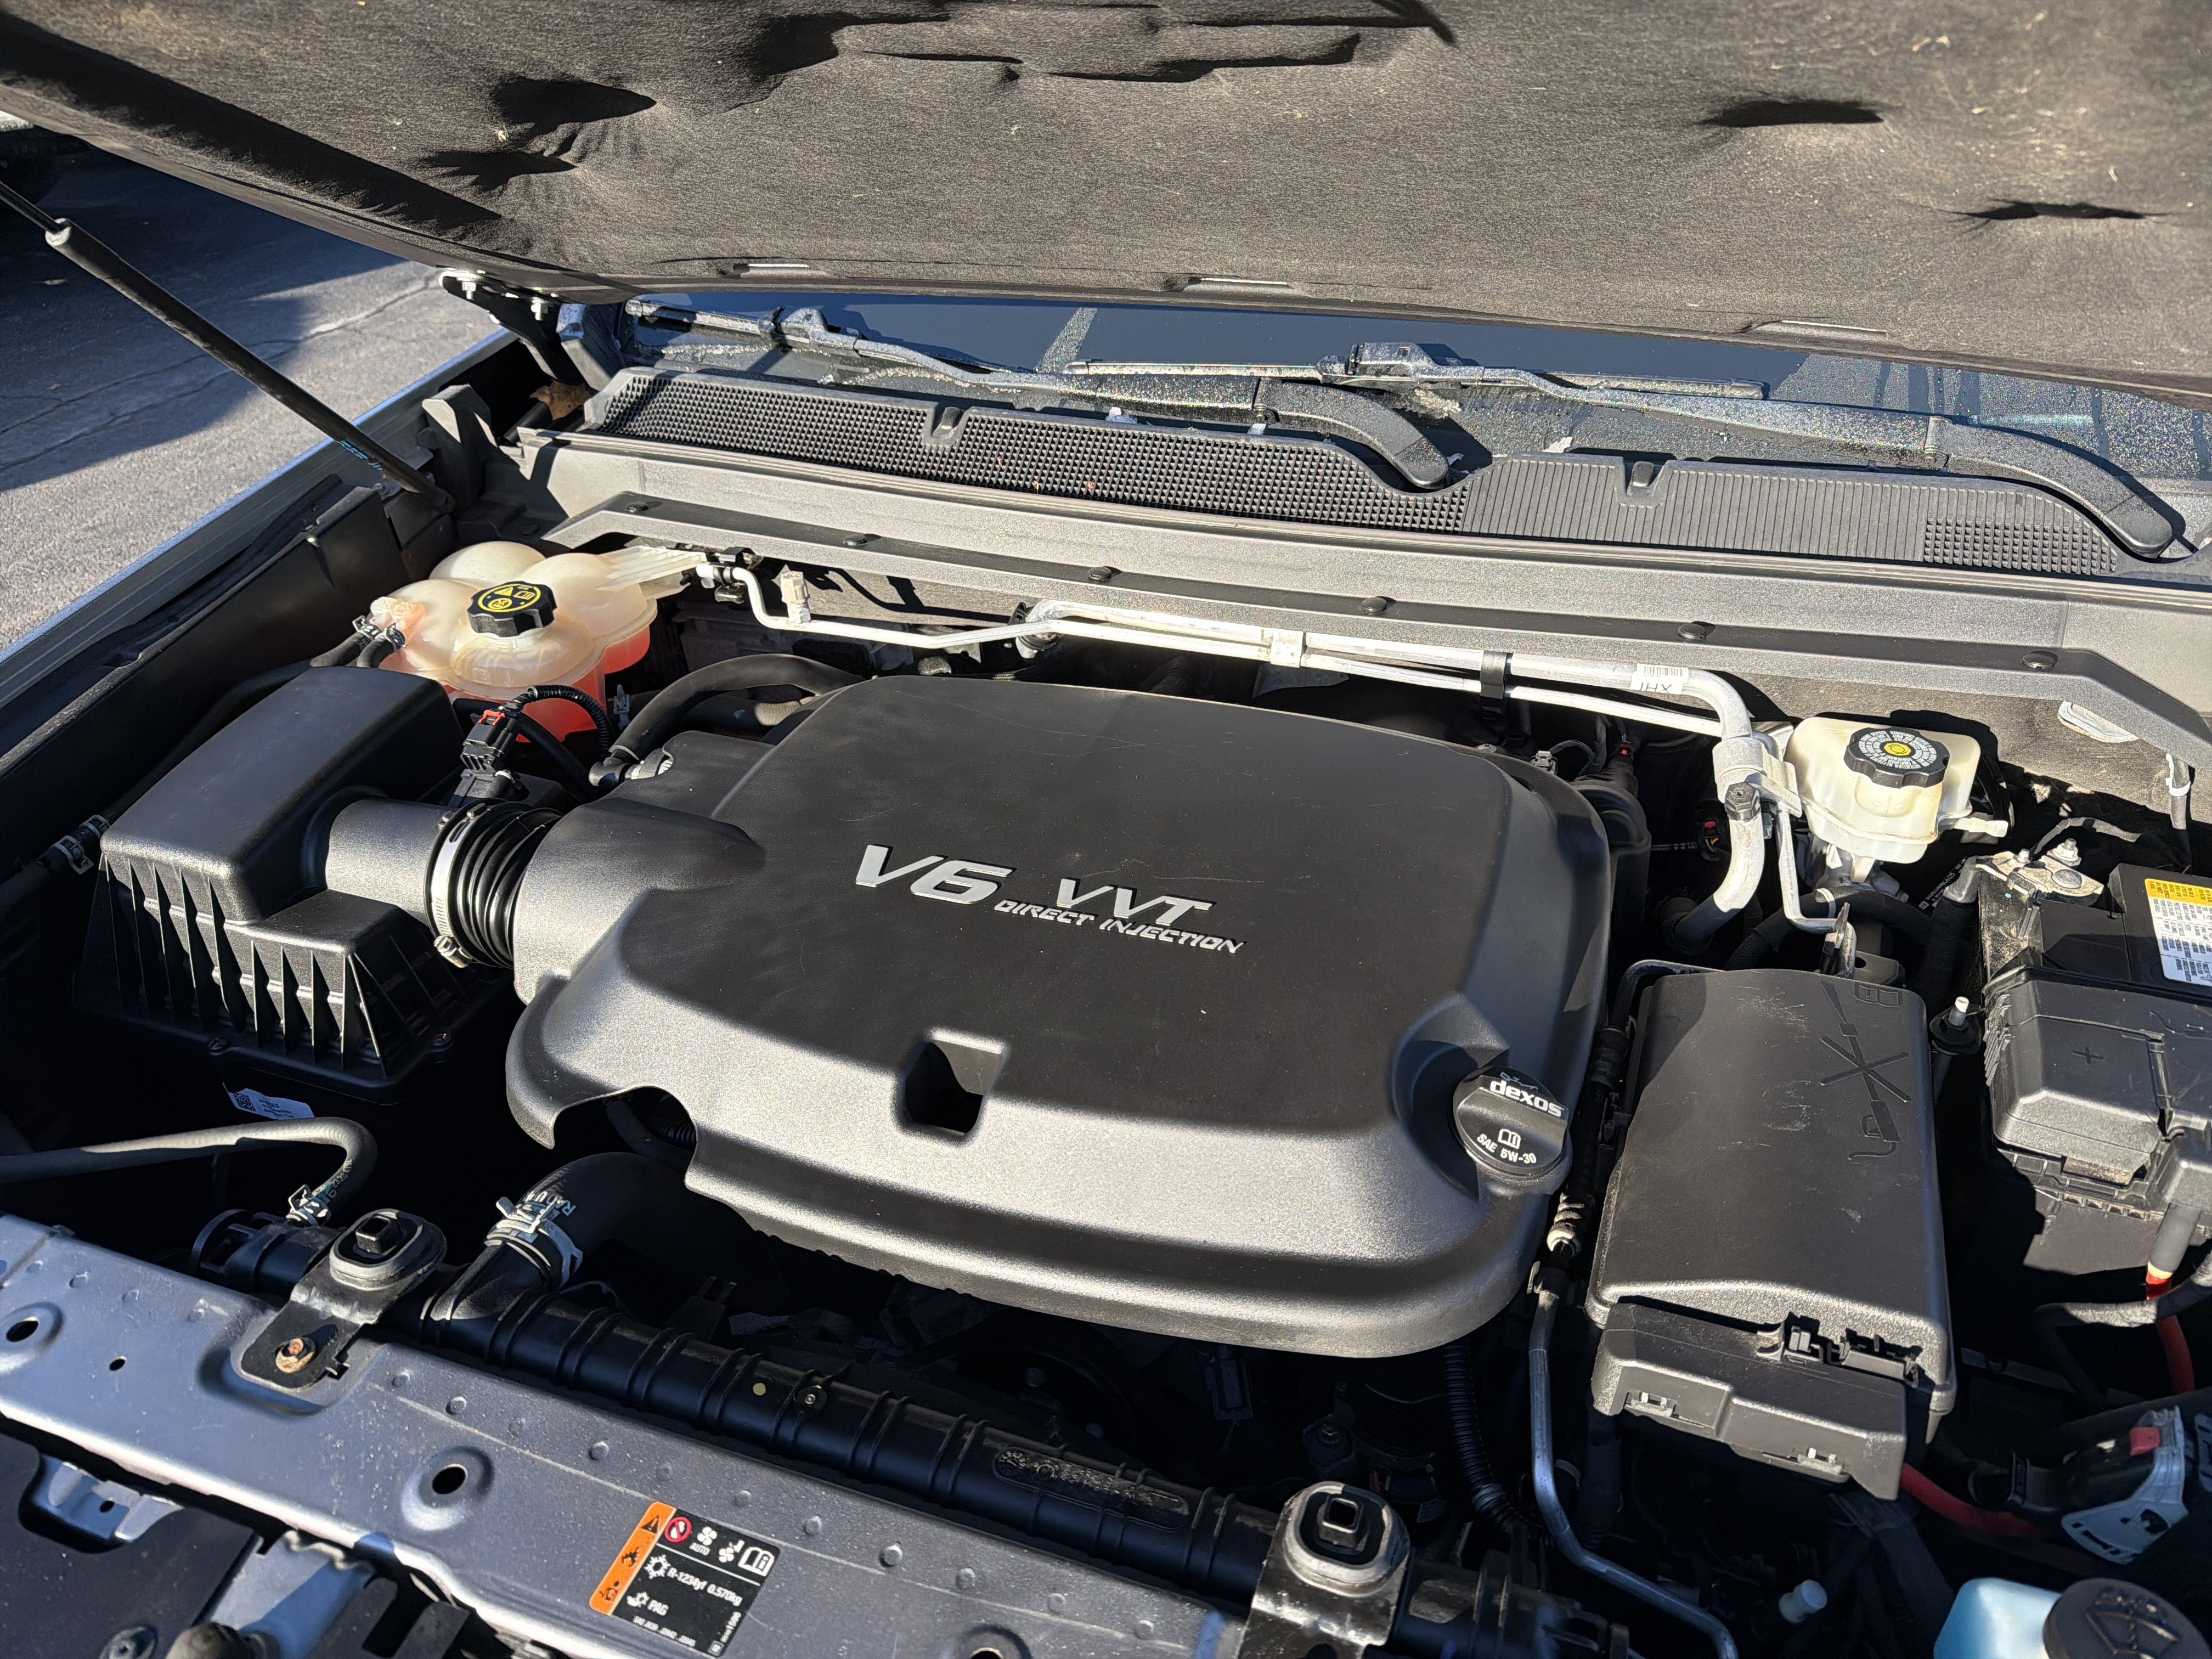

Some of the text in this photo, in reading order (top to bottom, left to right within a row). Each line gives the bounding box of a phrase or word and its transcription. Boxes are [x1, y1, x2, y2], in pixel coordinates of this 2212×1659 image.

[856, 844, 1214, 926] V6 VVT
[994, 899, 1246, 954] DIRECT INJECTION
[1489, 1080, 1562, 1118] dexos
[1477, 1133, 1537, 1164] SAE 5W-30
[689, 1542, 710, 1556] AUTO
[667, 1567, 743, 1606] R-1234yf 0.570kg
[647, 1600, 669, 1616] PAG
